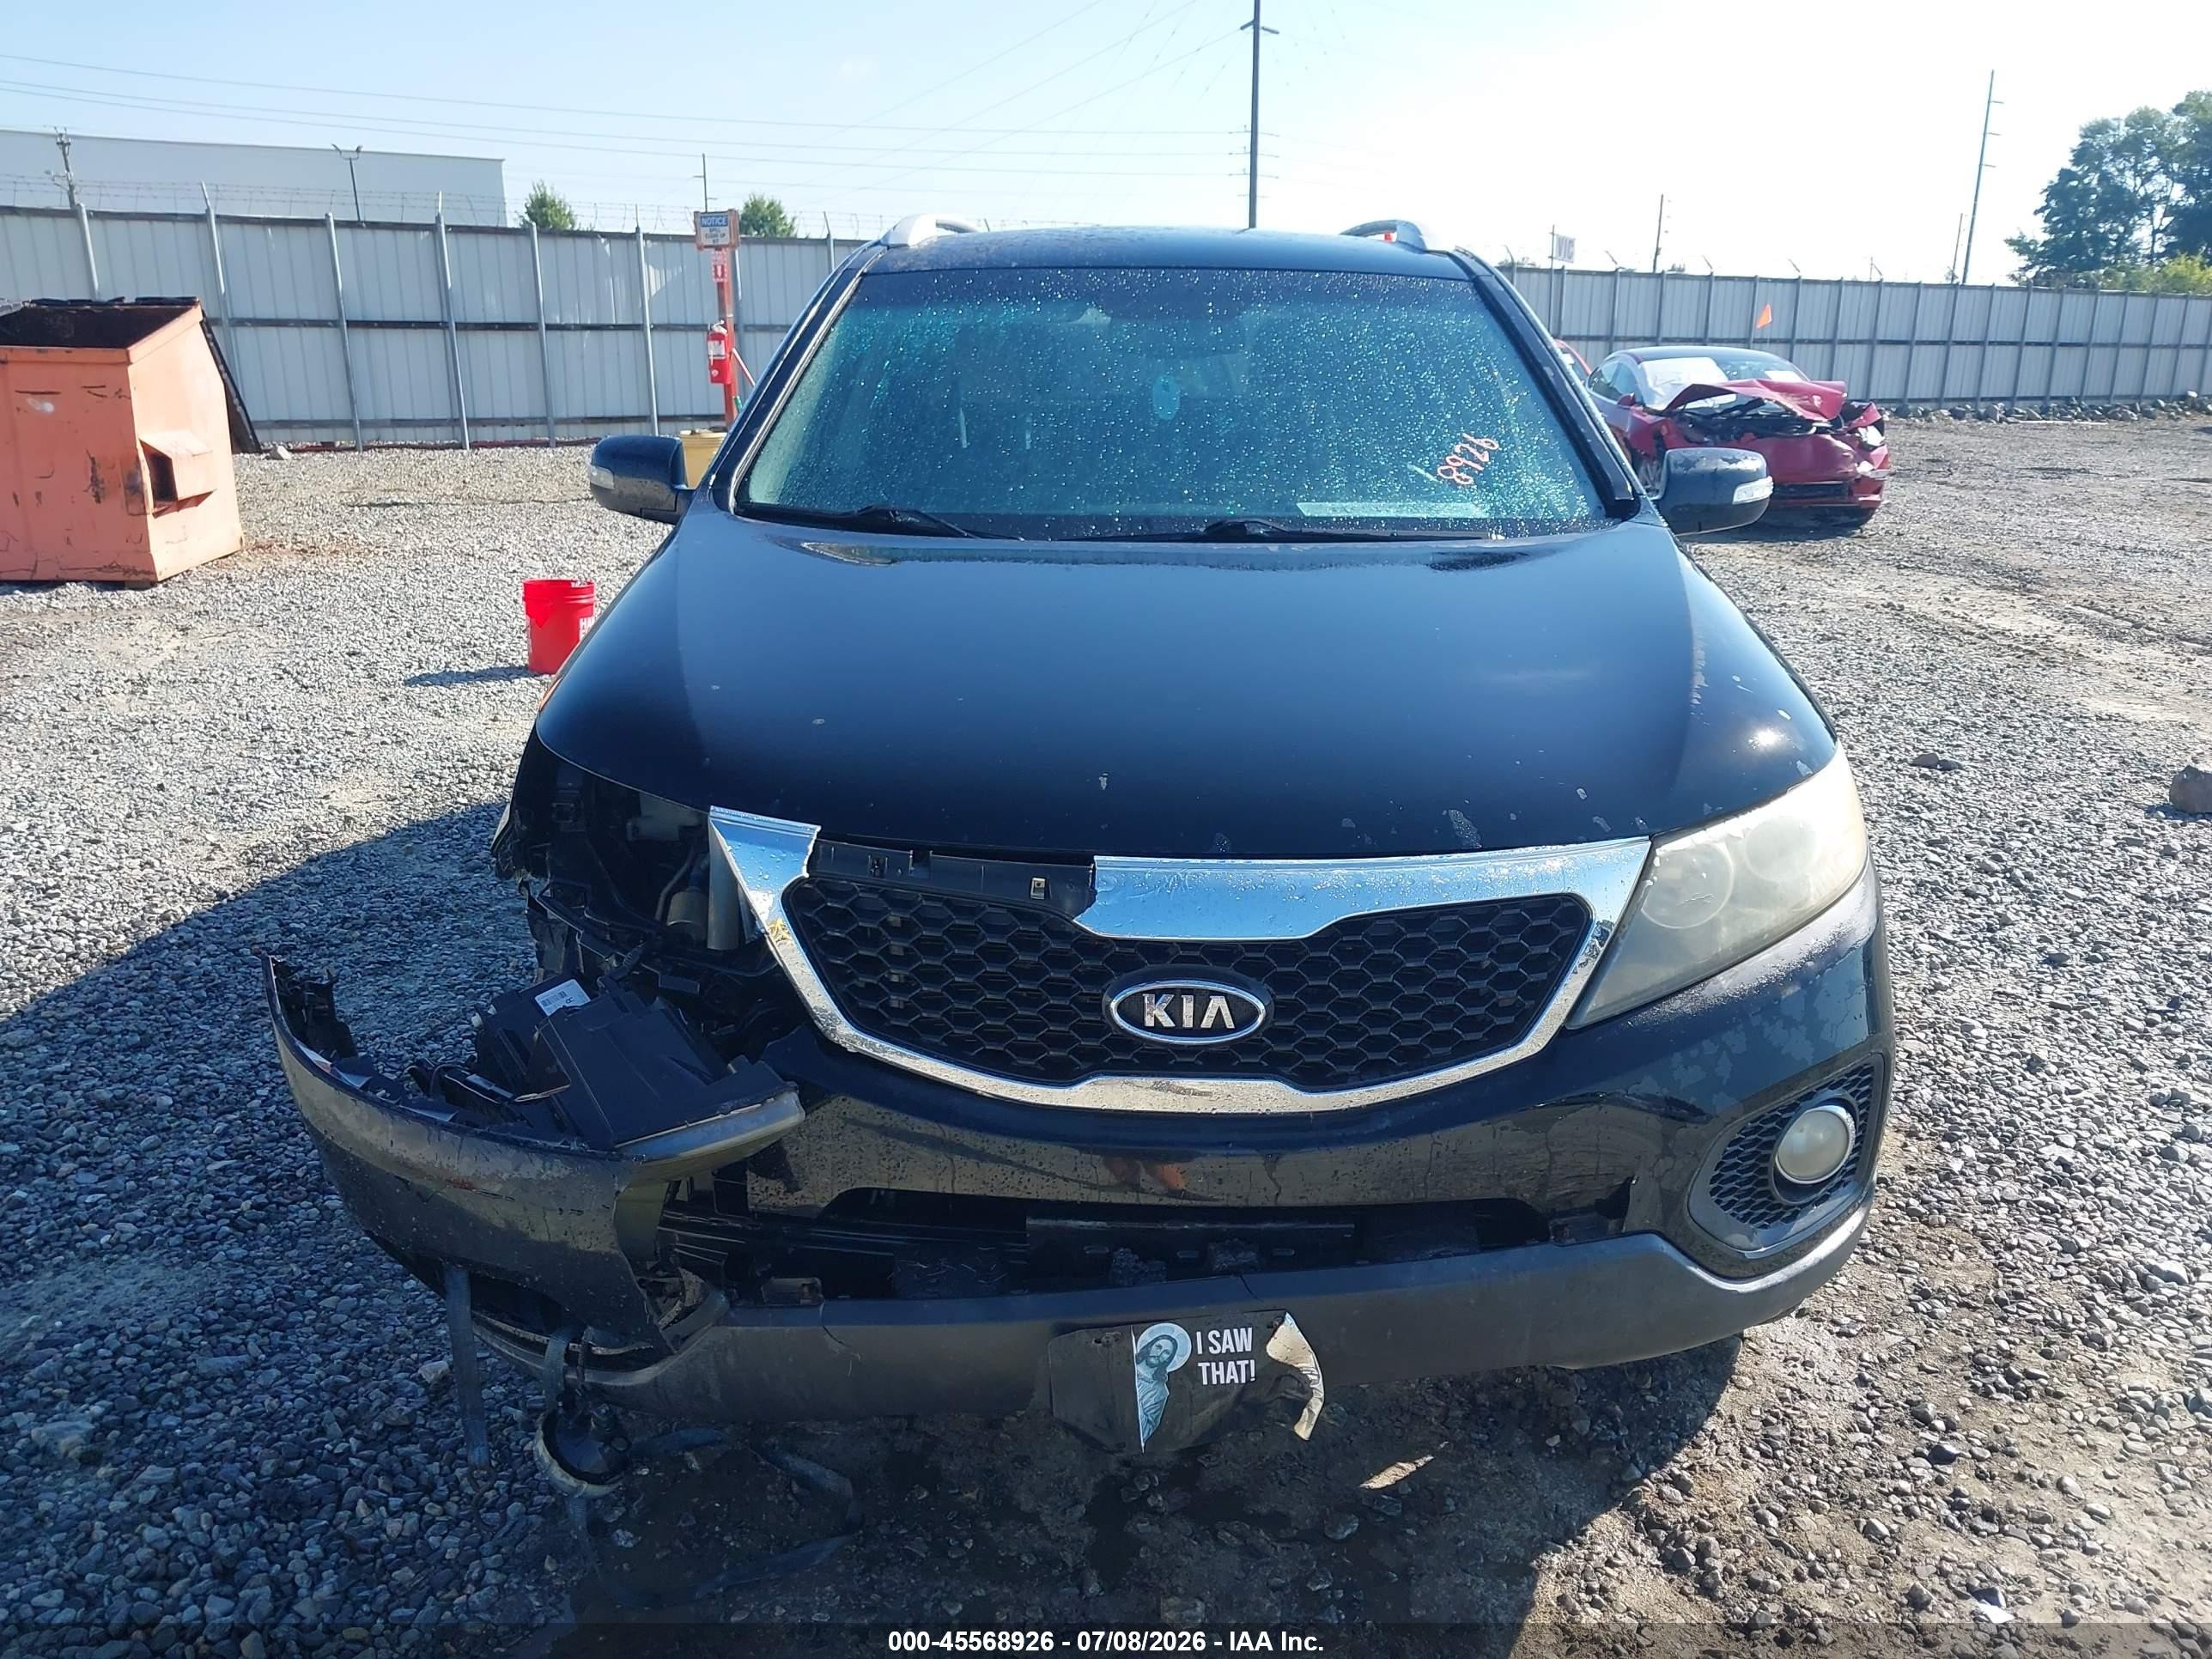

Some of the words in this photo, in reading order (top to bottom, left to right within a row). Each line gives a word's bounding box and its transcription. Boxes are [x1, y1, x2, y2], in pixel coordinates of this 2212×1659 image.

[702, 216, 727, 226] NOTICE
[1437, 432, 1500, 485] 8926
[1142, 993, 1236, 1030] KIA
[1196, 1331, 1203, 1355] I
[1208, 1327, 1253, 1354] SAW
[1197, 1358, 1255, 1385] THAT!
